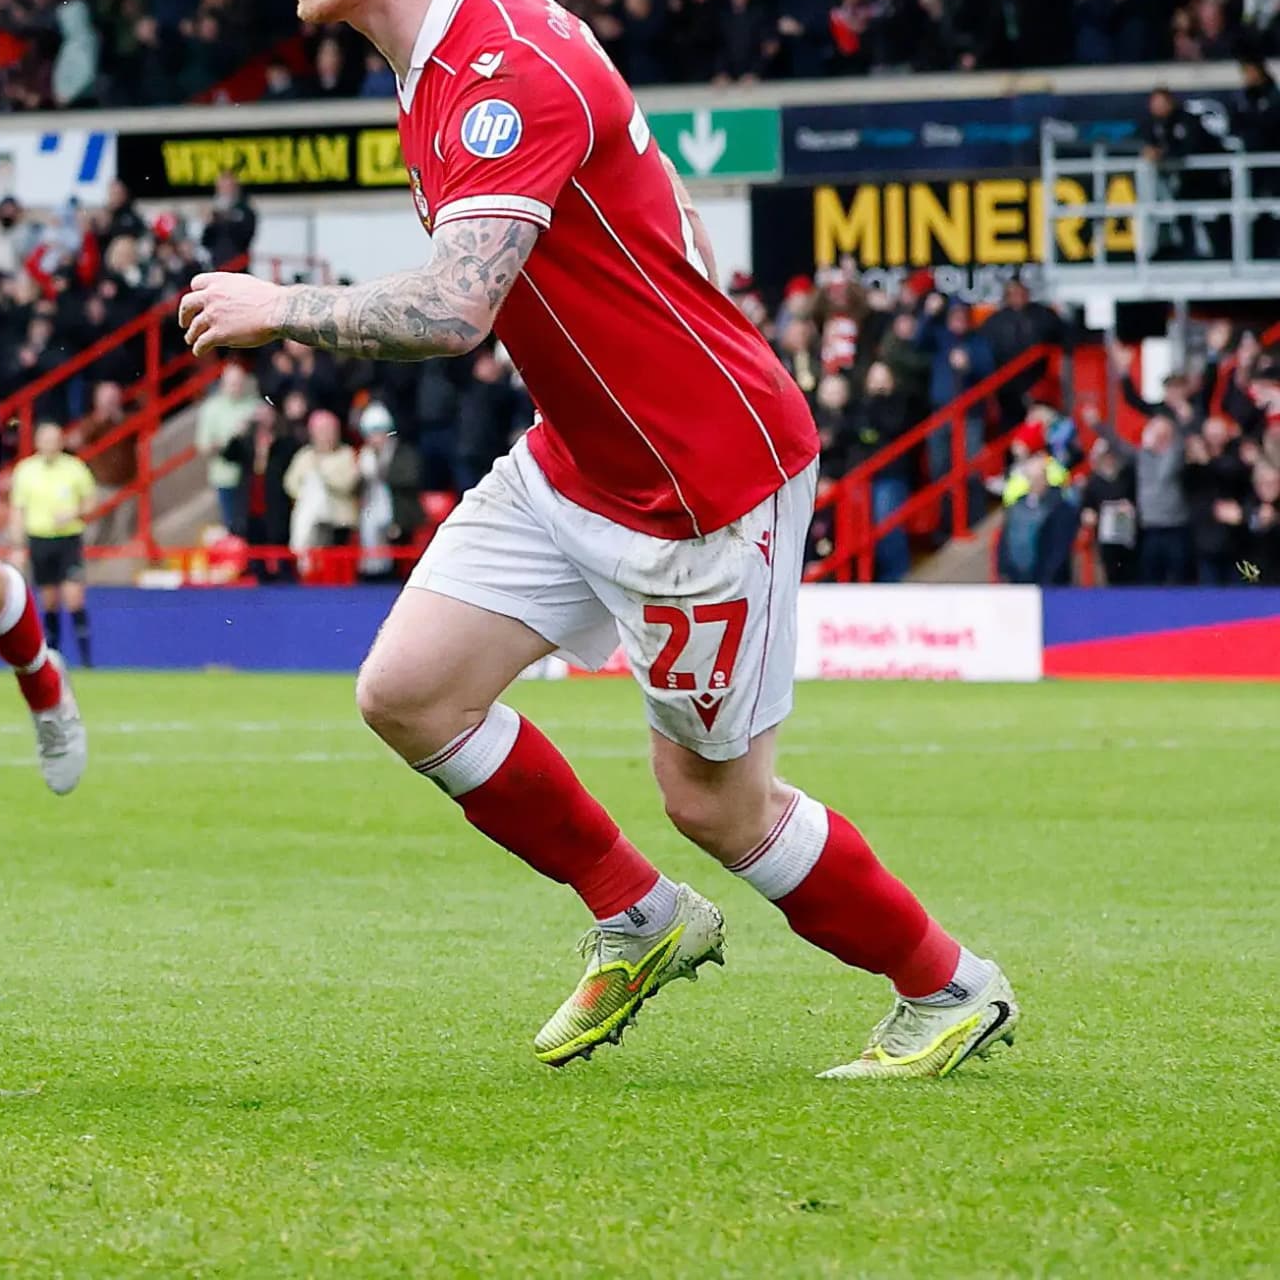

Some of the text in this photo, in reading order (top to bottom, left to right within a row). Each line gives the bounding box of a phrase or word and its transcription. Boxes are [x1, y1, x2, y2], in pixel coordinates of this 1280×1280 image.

[161, 135, 349, 186] WREXHAM
[466, 101, 518, 157] hp
[813, 175, 1139, 267] MINERA
[642, 597, 748, 691] 27
